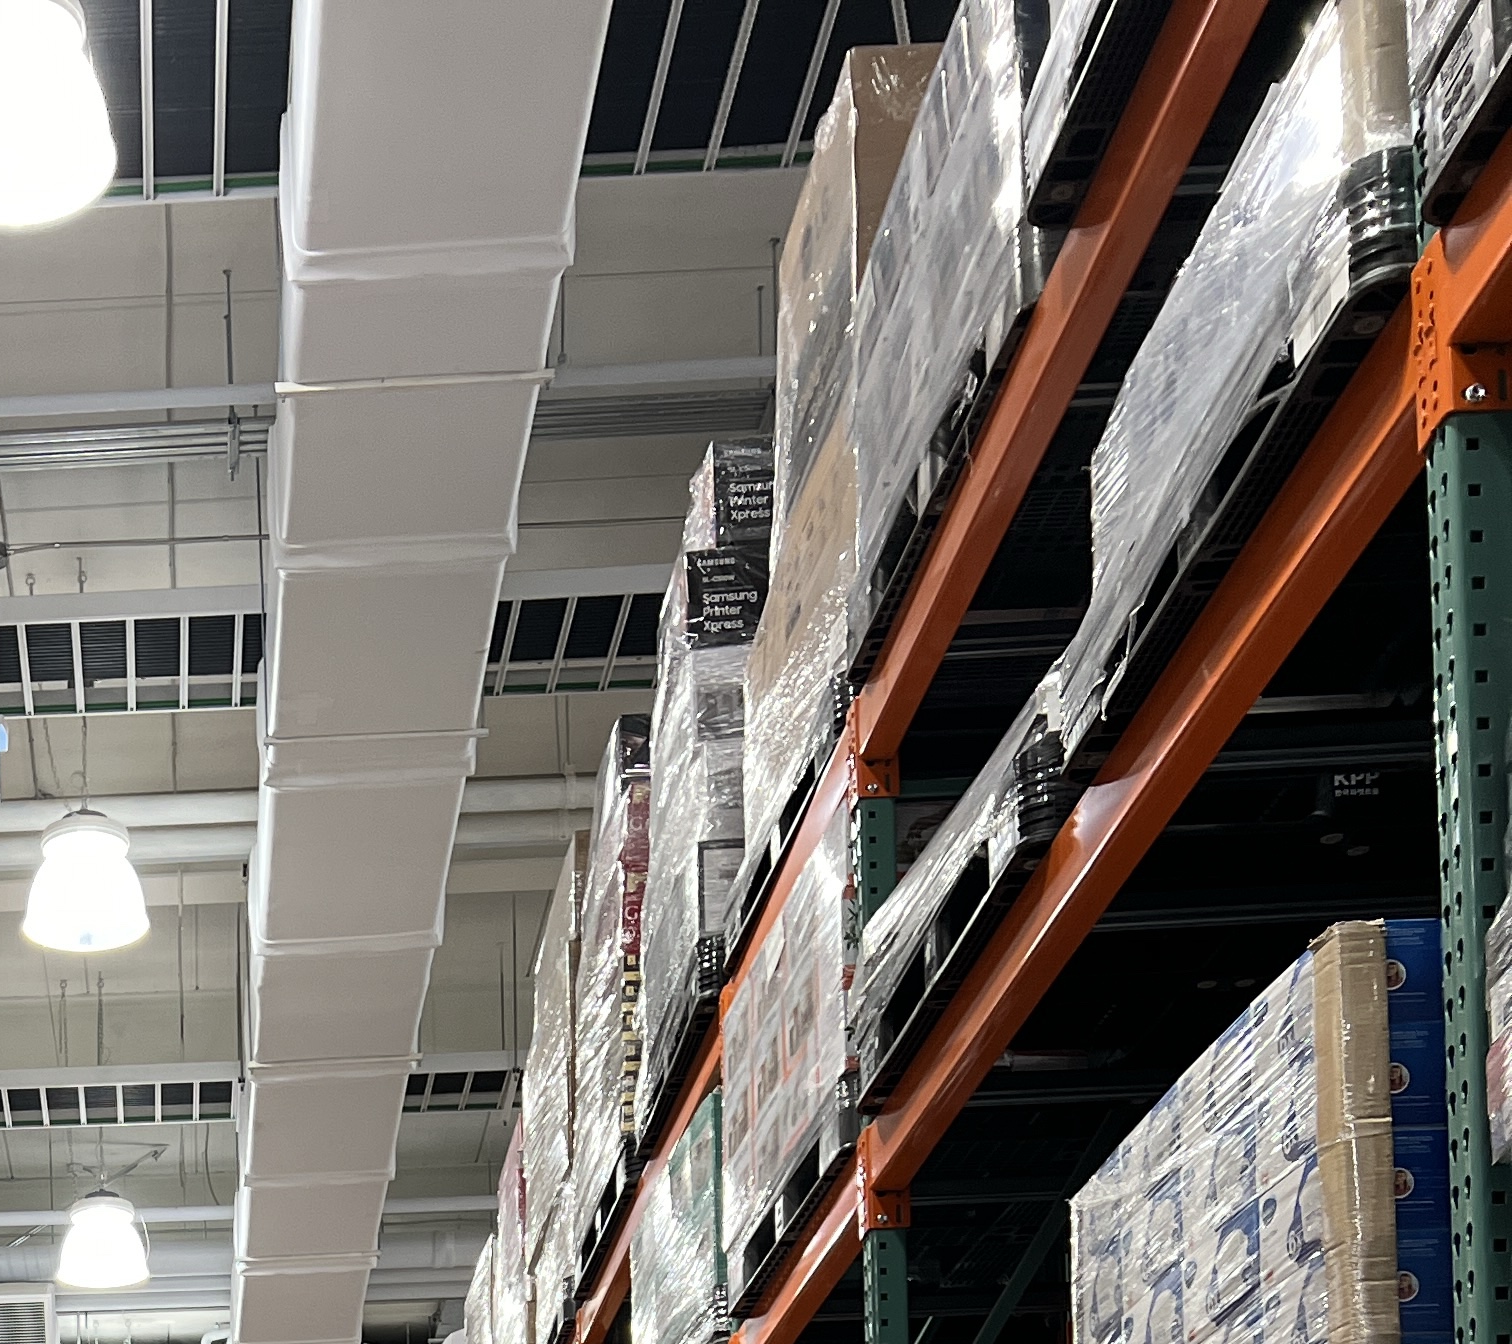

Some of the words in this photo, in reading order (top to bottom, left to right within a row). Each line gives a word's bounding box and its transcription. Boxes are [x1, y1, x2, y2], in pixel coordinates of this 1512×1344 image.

[730, 509, 771, 523] Xpress
[697, 557, 735, 567] SAMSUNG
[702, 590, 758, 604] Samsung
[702, 606, 742, 617] Printer
[703, 619, 744, 633] Xpress
